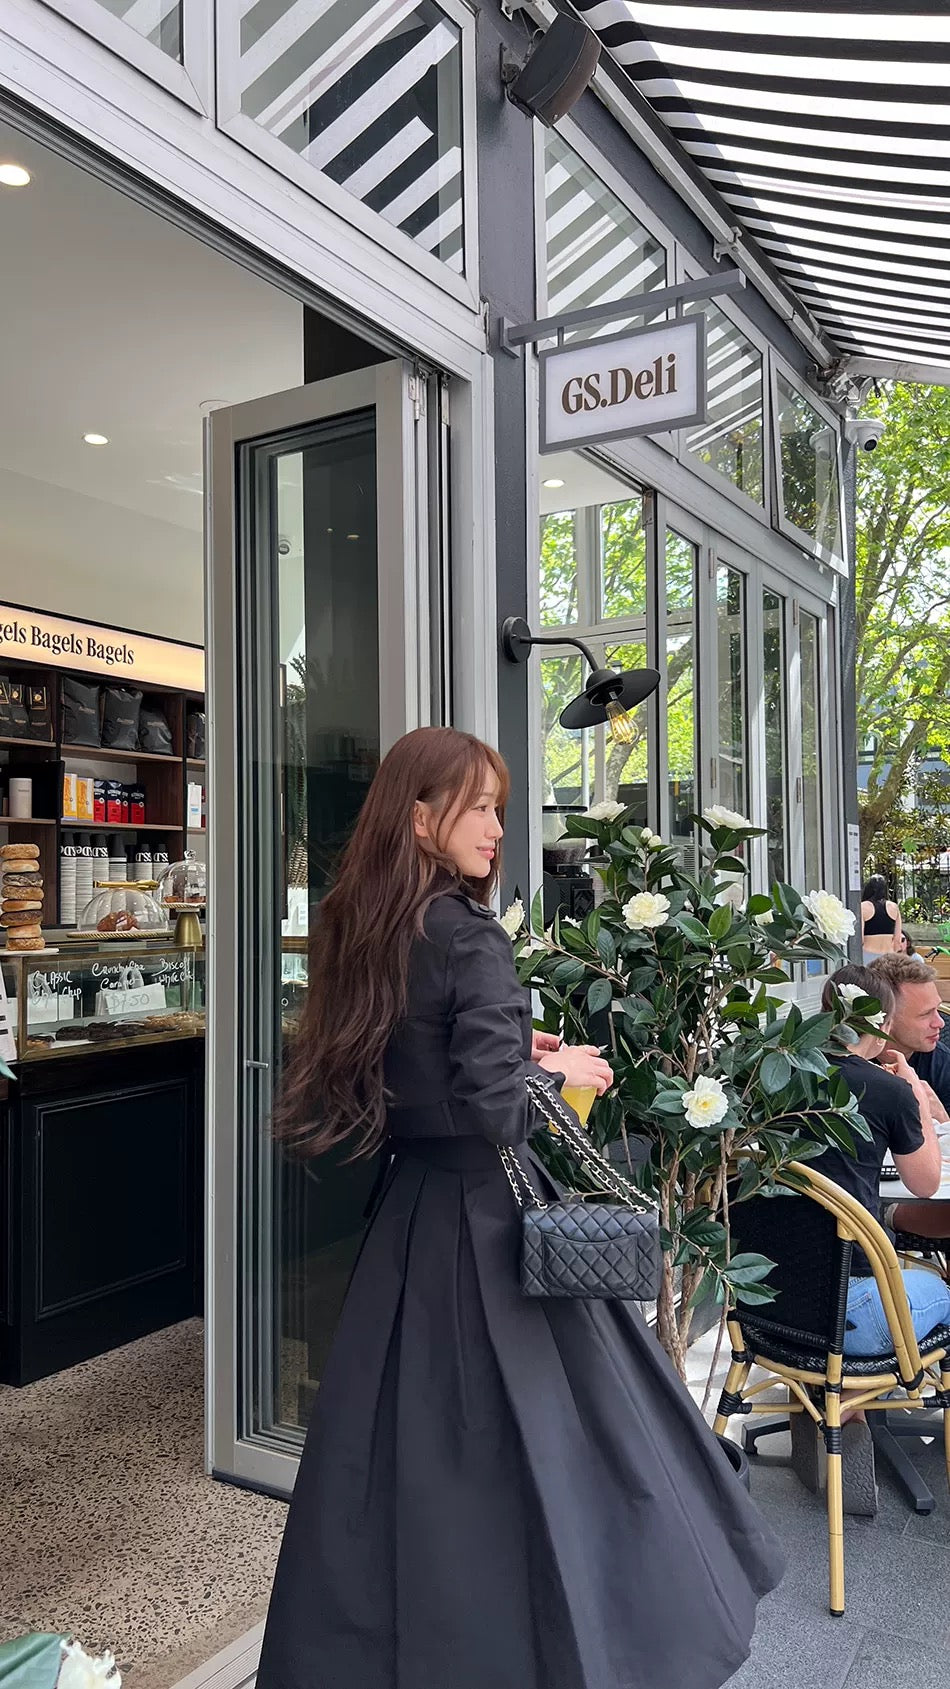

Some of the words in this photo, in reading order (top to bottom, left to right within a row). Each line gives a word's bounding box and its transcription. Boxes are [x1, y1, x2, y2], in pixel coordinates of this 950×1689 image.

[561, 353, 677, 415] GS.Deli
[30, 625, 83, 655] Bagels
[86, 637, 135, 665] Bagels
